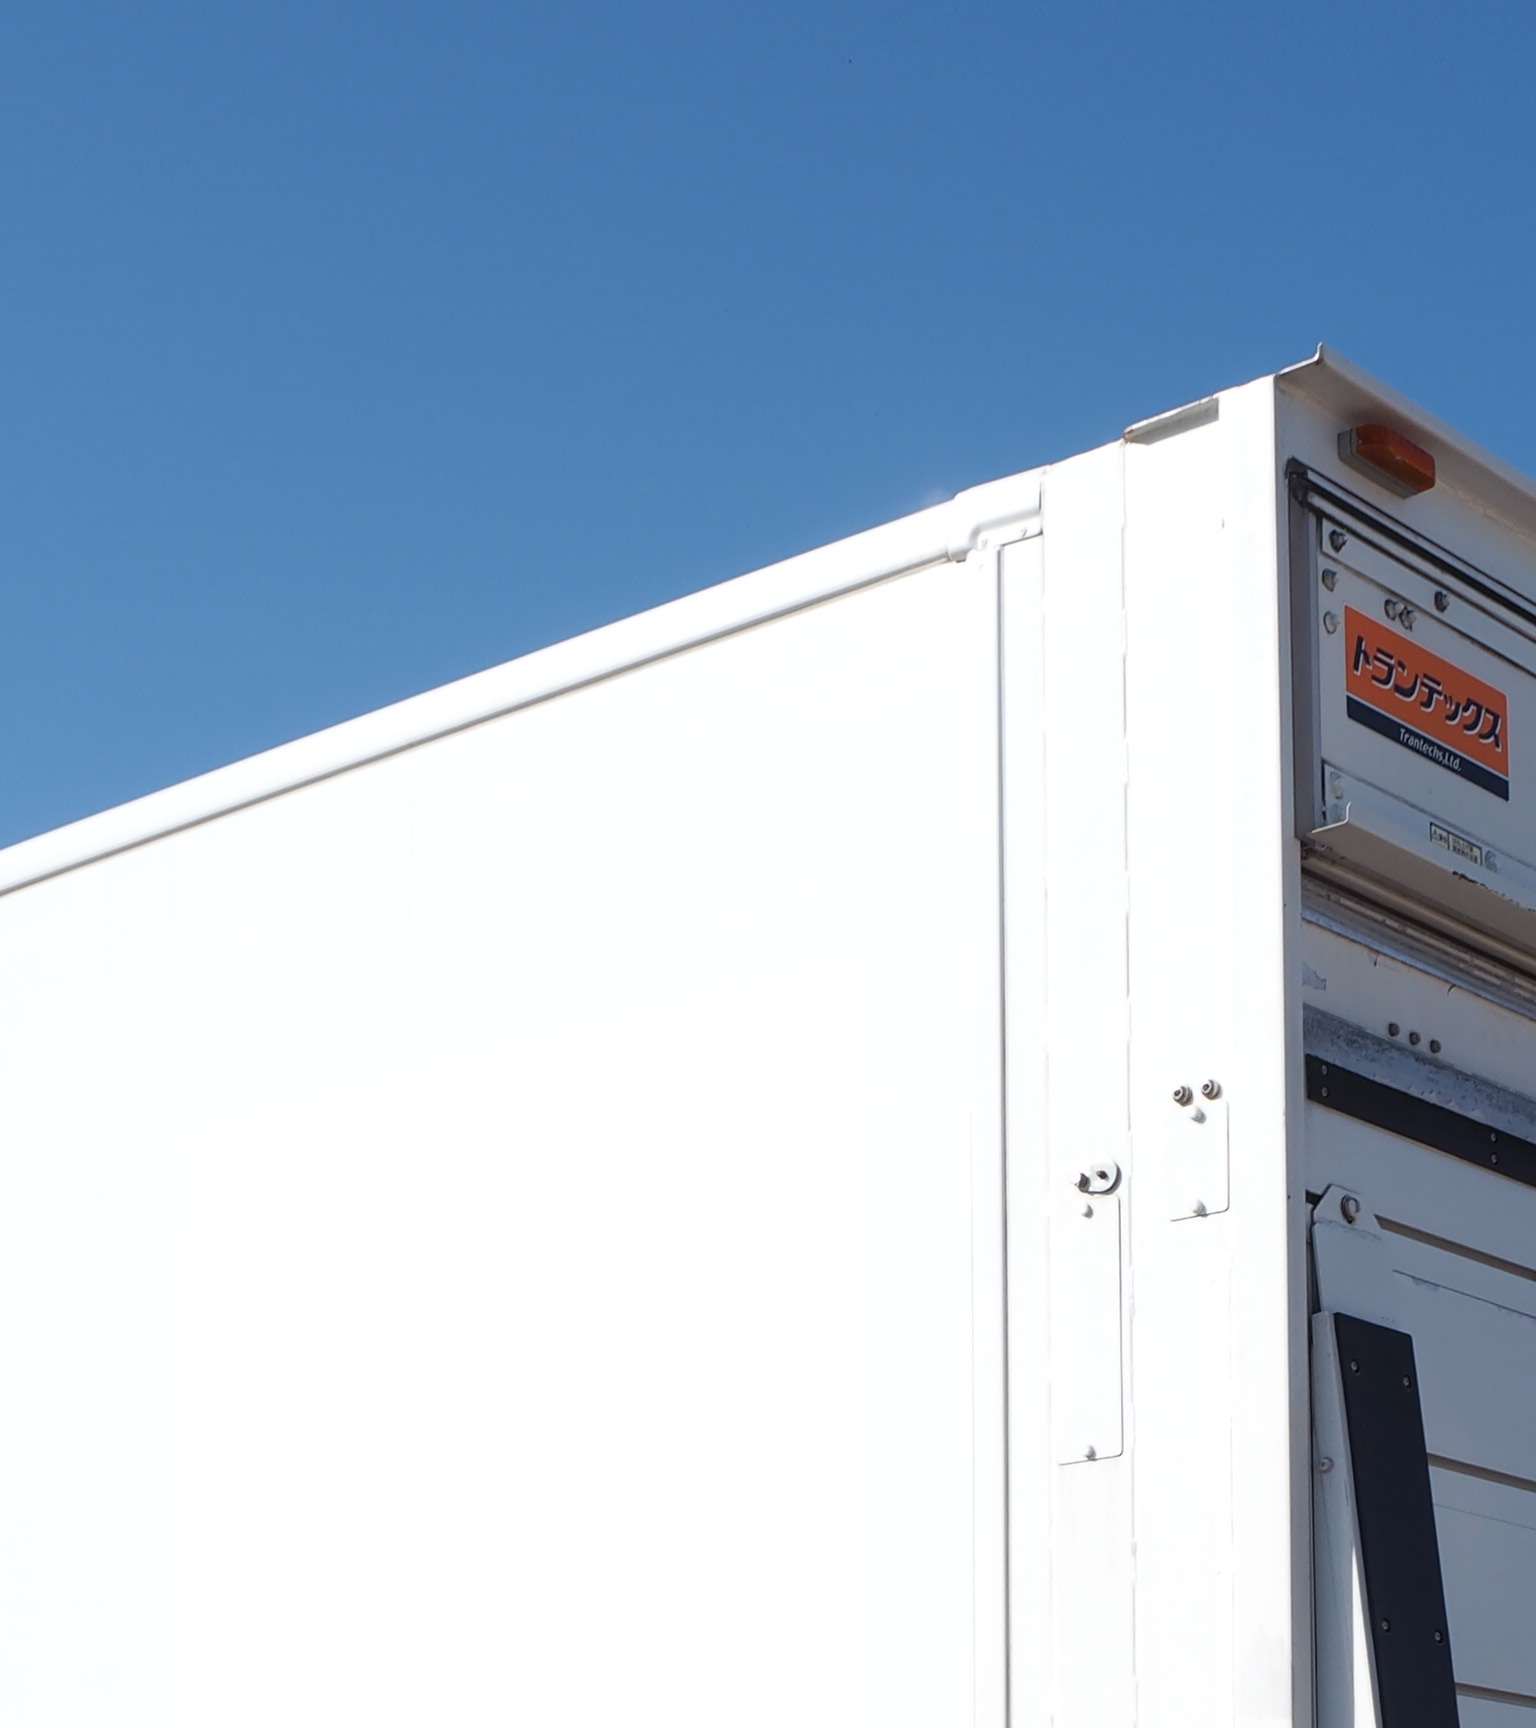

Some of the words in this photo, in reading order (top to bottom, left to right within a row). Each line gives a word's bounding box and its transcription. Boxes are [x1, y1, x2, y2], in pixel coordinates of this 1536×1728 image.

[1352, 635, 1503, 752] トランテックス
